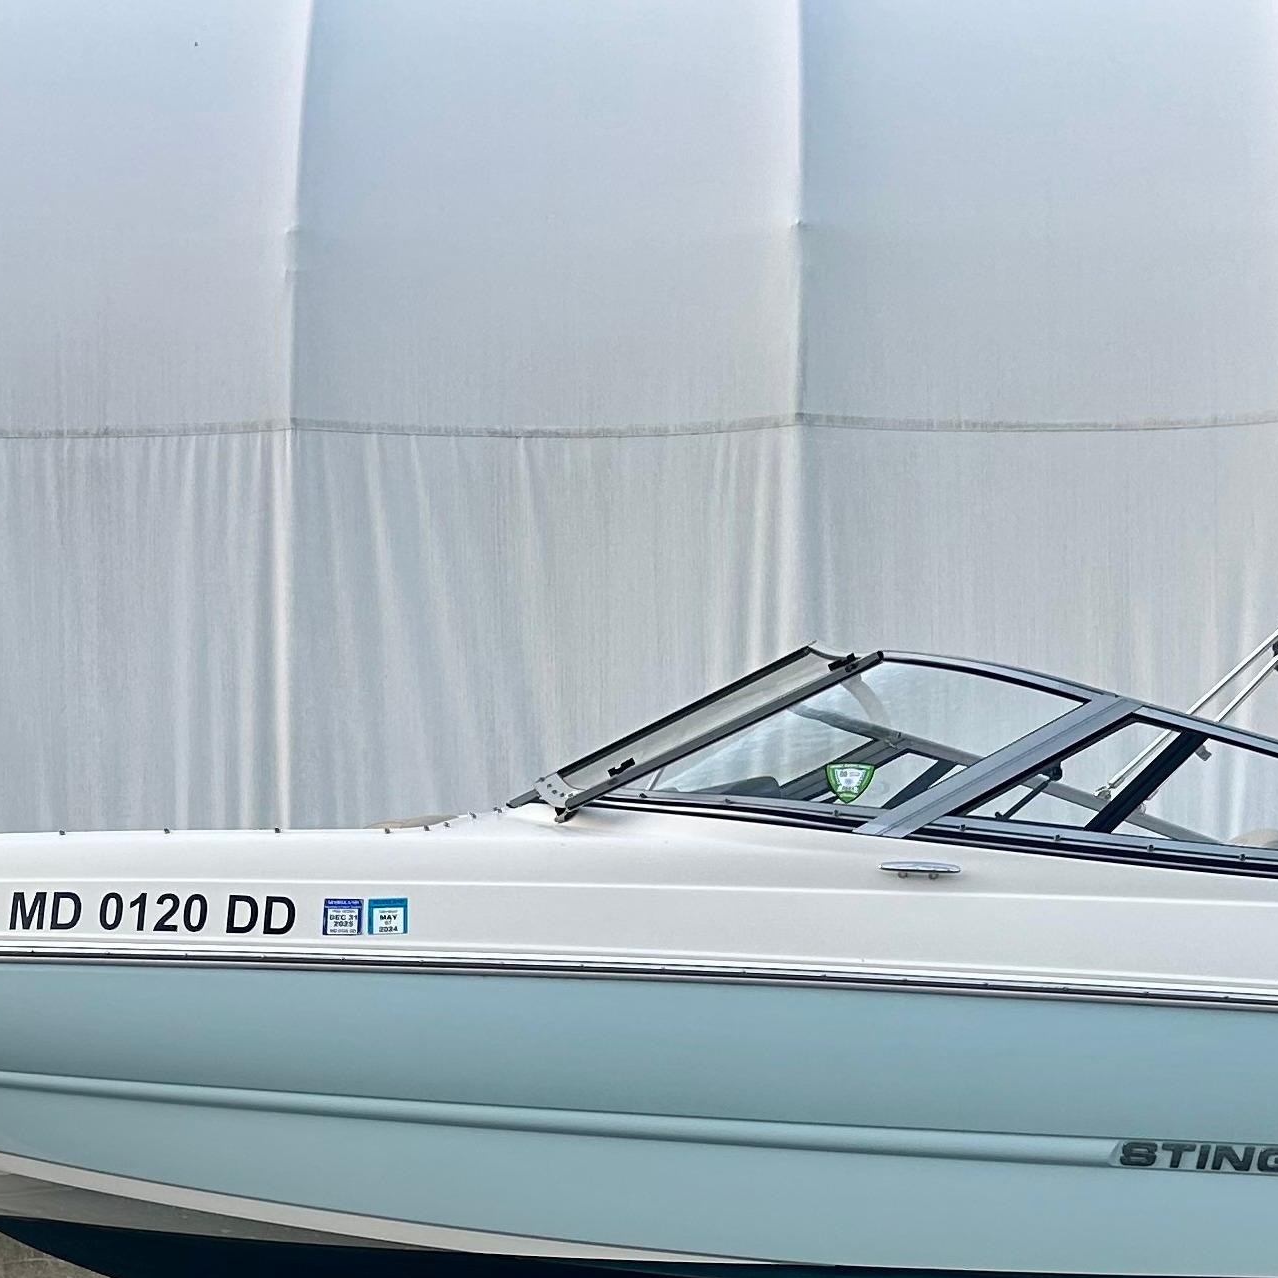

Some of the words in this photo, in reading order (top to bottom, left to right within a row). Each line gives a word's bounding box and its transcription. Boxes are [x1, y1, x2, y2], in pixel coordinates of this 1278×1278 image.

[9, 891, 86, 931] MD
[99, 891, 209, 932] 0120
[225, 894, 297, 935] DD
